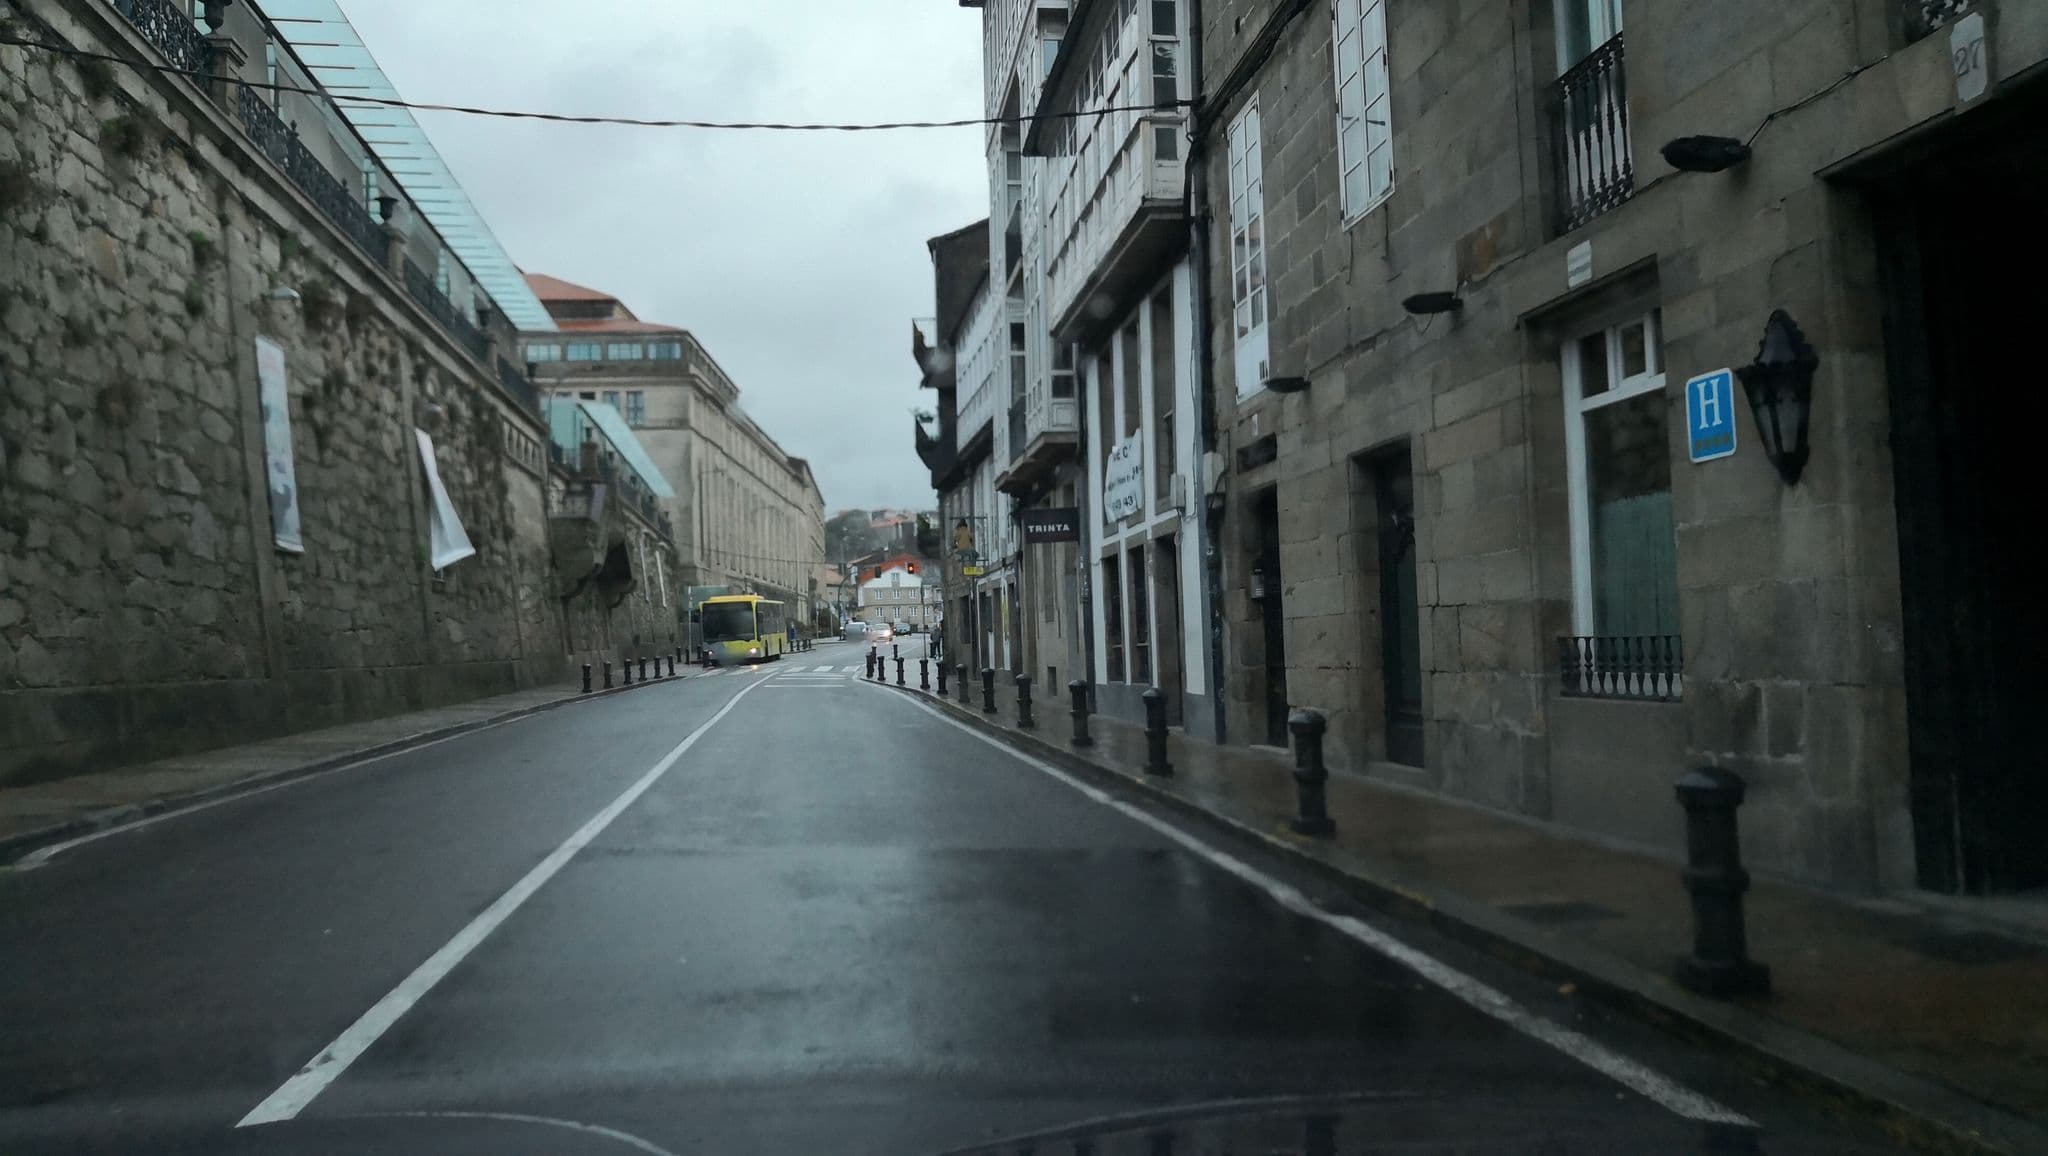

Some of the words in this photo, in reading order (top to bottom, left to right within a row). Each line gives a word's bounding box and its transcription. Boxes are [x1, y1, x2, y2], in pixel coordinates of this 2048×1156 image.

[1953, 37, 1983, 79] 27
[1697, 378, 1723, 430] H
[1028, 523, 1070, 534] TRINTA
